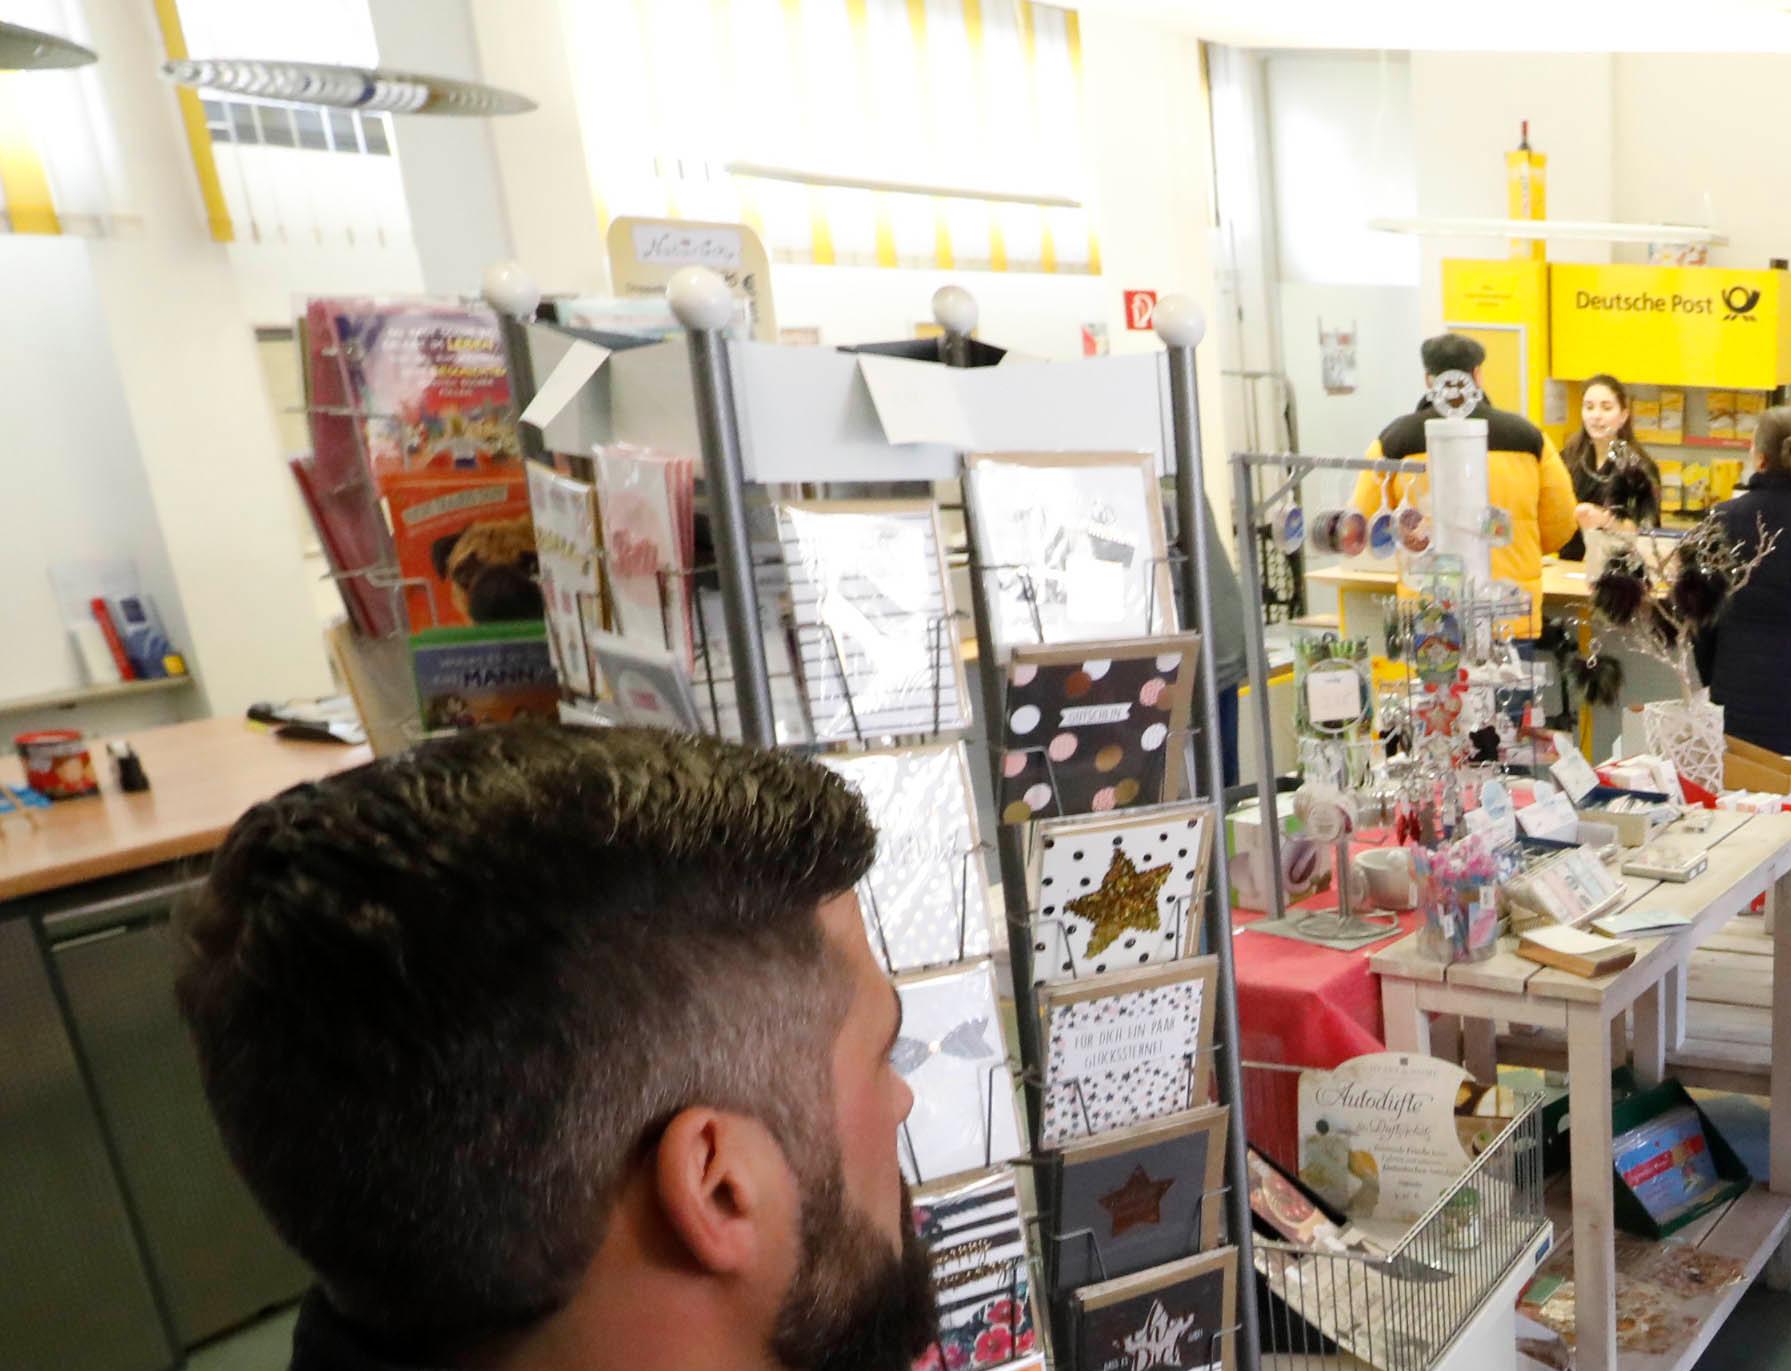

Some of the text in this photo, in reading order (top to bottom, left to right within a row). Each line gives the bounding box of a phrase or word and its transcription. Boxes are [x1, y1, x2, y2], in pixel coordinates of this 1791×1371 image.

[1576, 290, 1713, 315] Deutsche Post
[1099, 1027, 1122, 1045] DICH
[1315, 1081, 1435, 1119] Autodüfte
